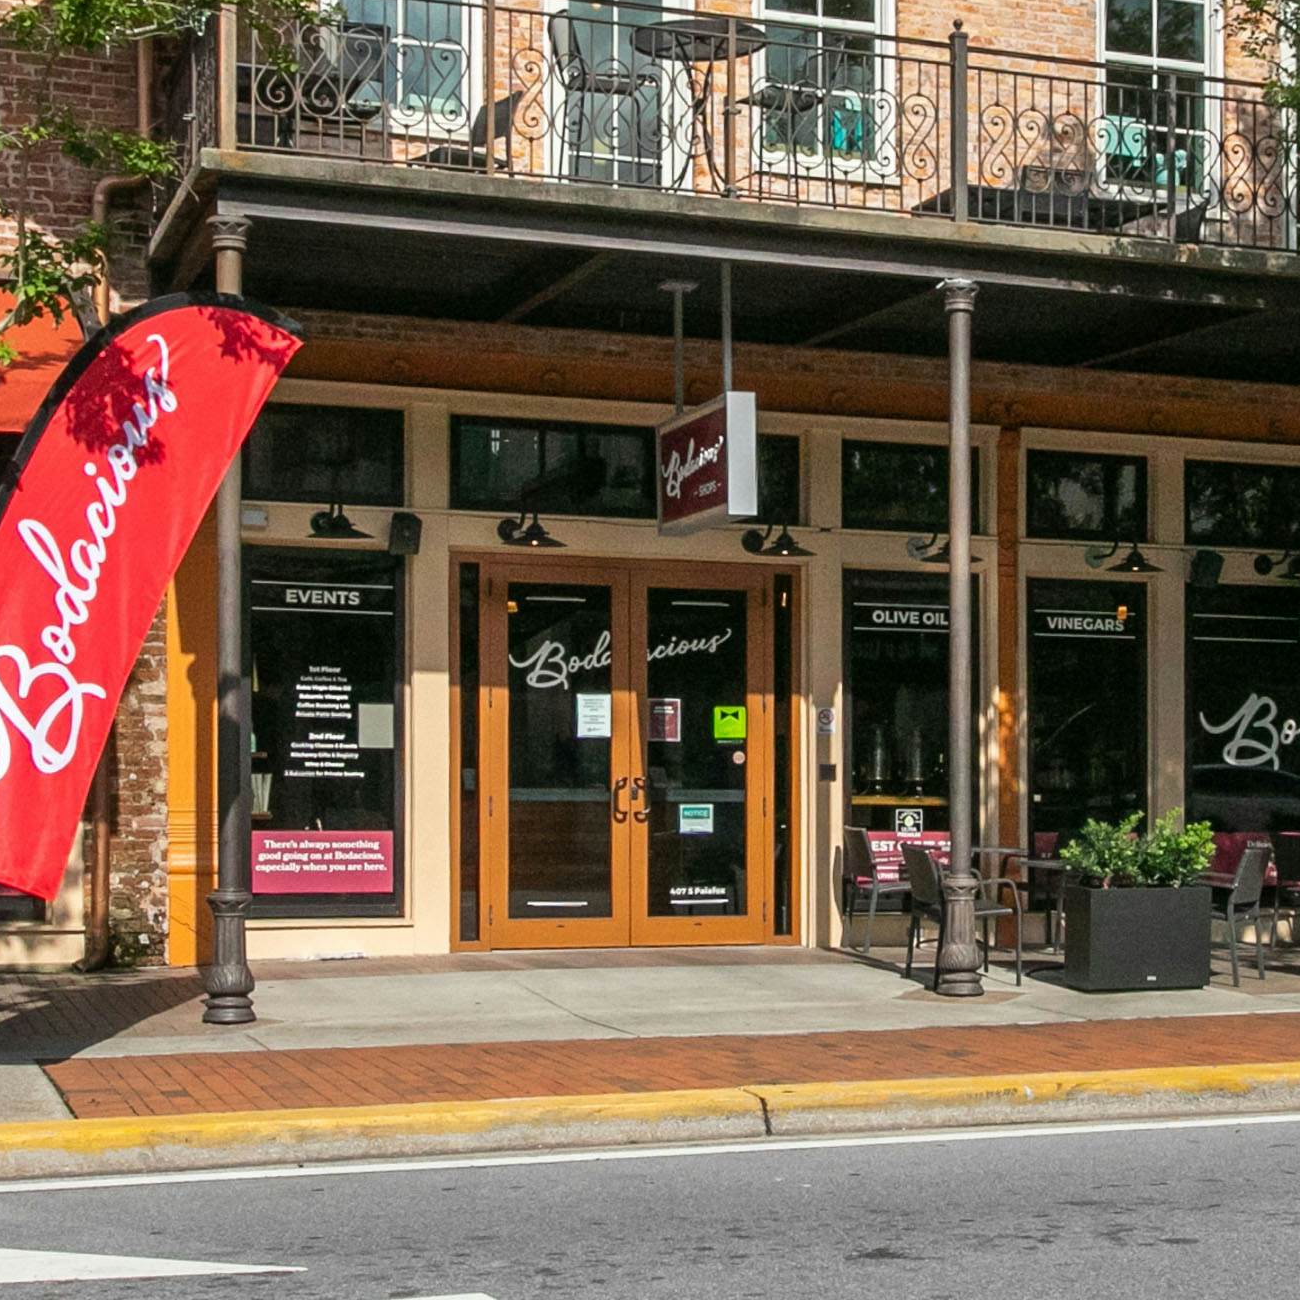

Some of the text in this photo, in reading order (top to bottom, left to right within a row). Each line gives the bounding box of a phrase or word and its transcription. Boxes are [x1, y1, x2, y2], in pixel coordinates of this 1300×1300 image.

[661, 435, 724, 498] Bodacious
[285, 588, 361, 605] EVENTS
[872, 610, 949, 625] OLIVE OIL
[1046, 616, 1125, 632] VINEGARS
[684, 809, 709, 817] NOTICE
[299, 840, 331, 850] always
[331, 840, 380, 850] something
[258, 851, 282, 862] good
[282, 851, 309, 862] going
[323, 852, 333, 860] at
[334, 850, 385, 861] Bodacious,
[255, 862, 301, 873] especially
[302, 862, 328, 871] when
[328, 863, 346, 872] you
[363, 862, 388, 871] here.
[669, 886, 726, 895] 407 S Palafox
